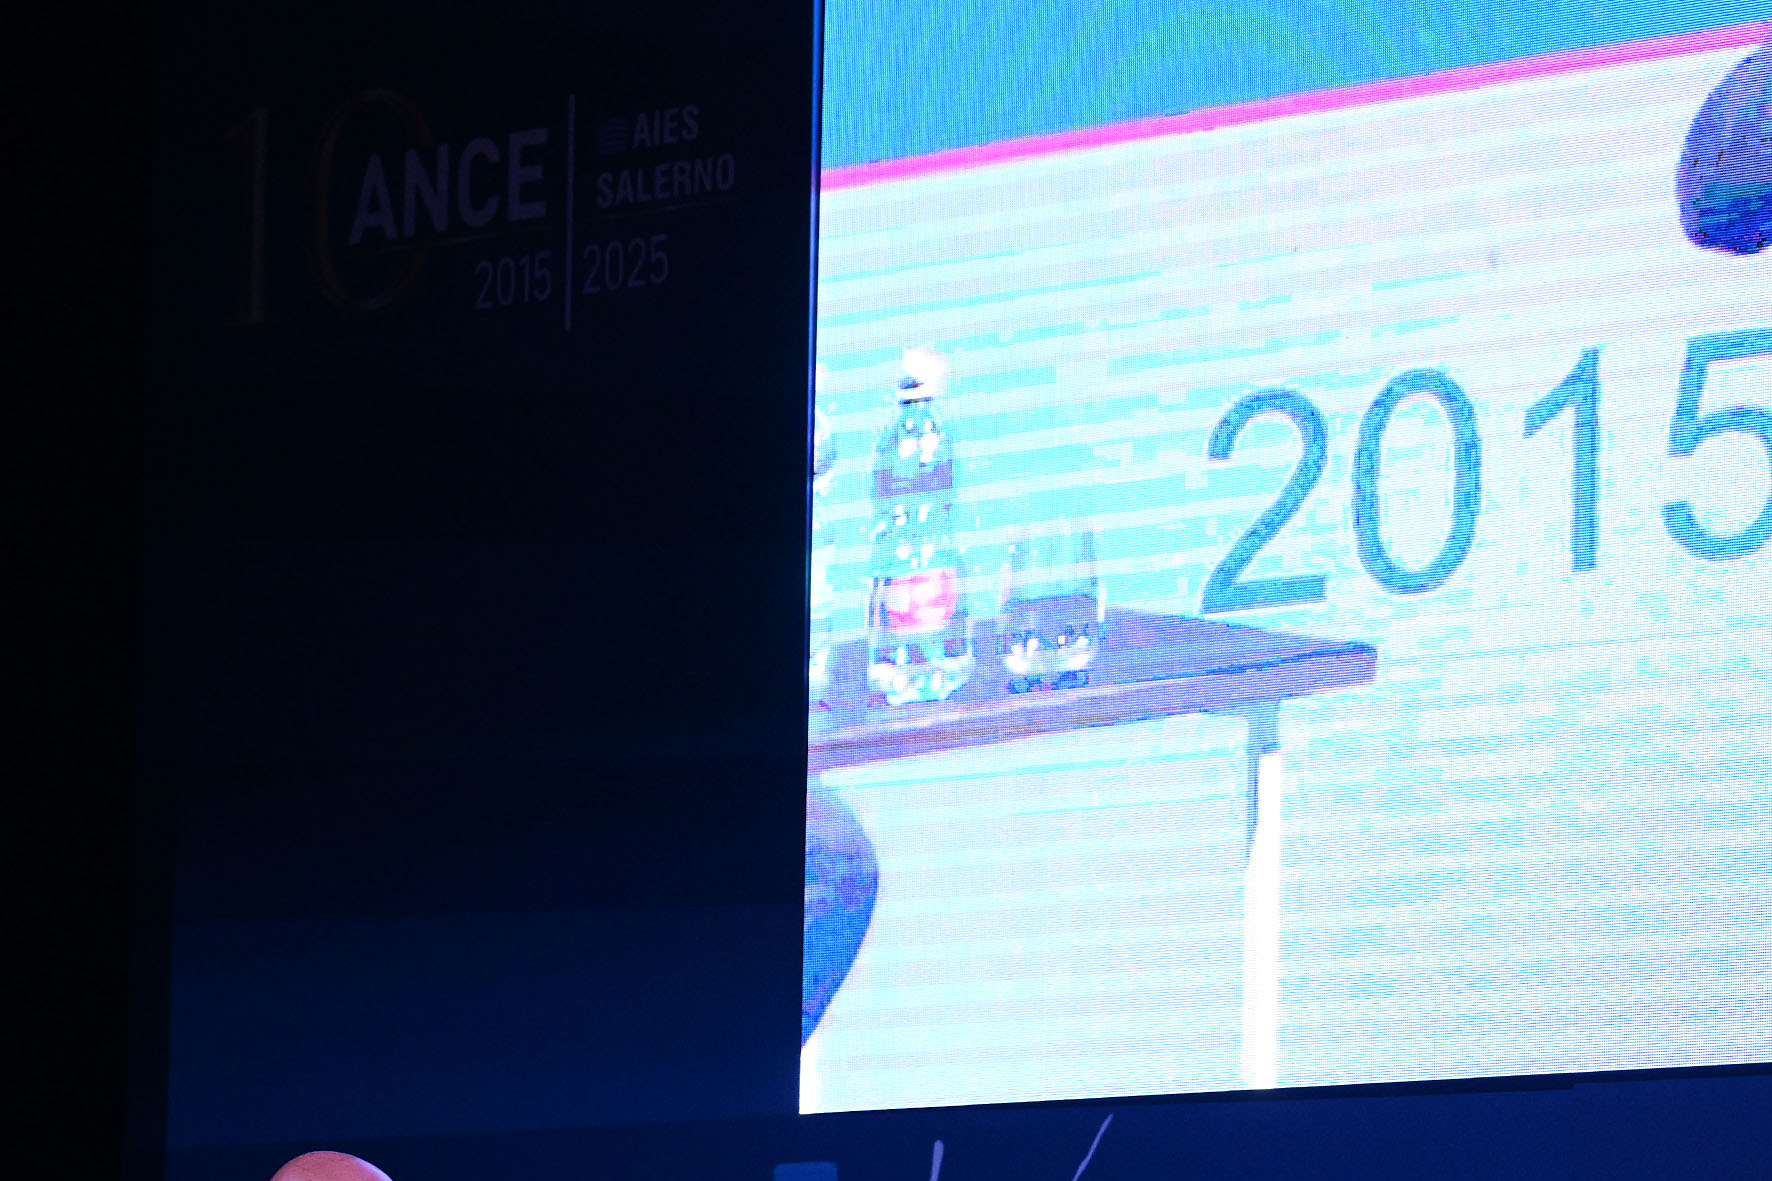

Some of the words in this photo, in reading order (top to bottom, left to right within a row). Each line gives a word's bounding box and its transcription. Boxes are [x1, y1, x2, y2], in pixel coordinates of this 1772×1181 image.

[630, 104, 701, 150] AIES
[349, 127, 549, 246] ANCE
[595, 153, 736, 210] SALERNO
[474, 249, 553, 310] 2015
[581, 233, 670, 296] 2025
